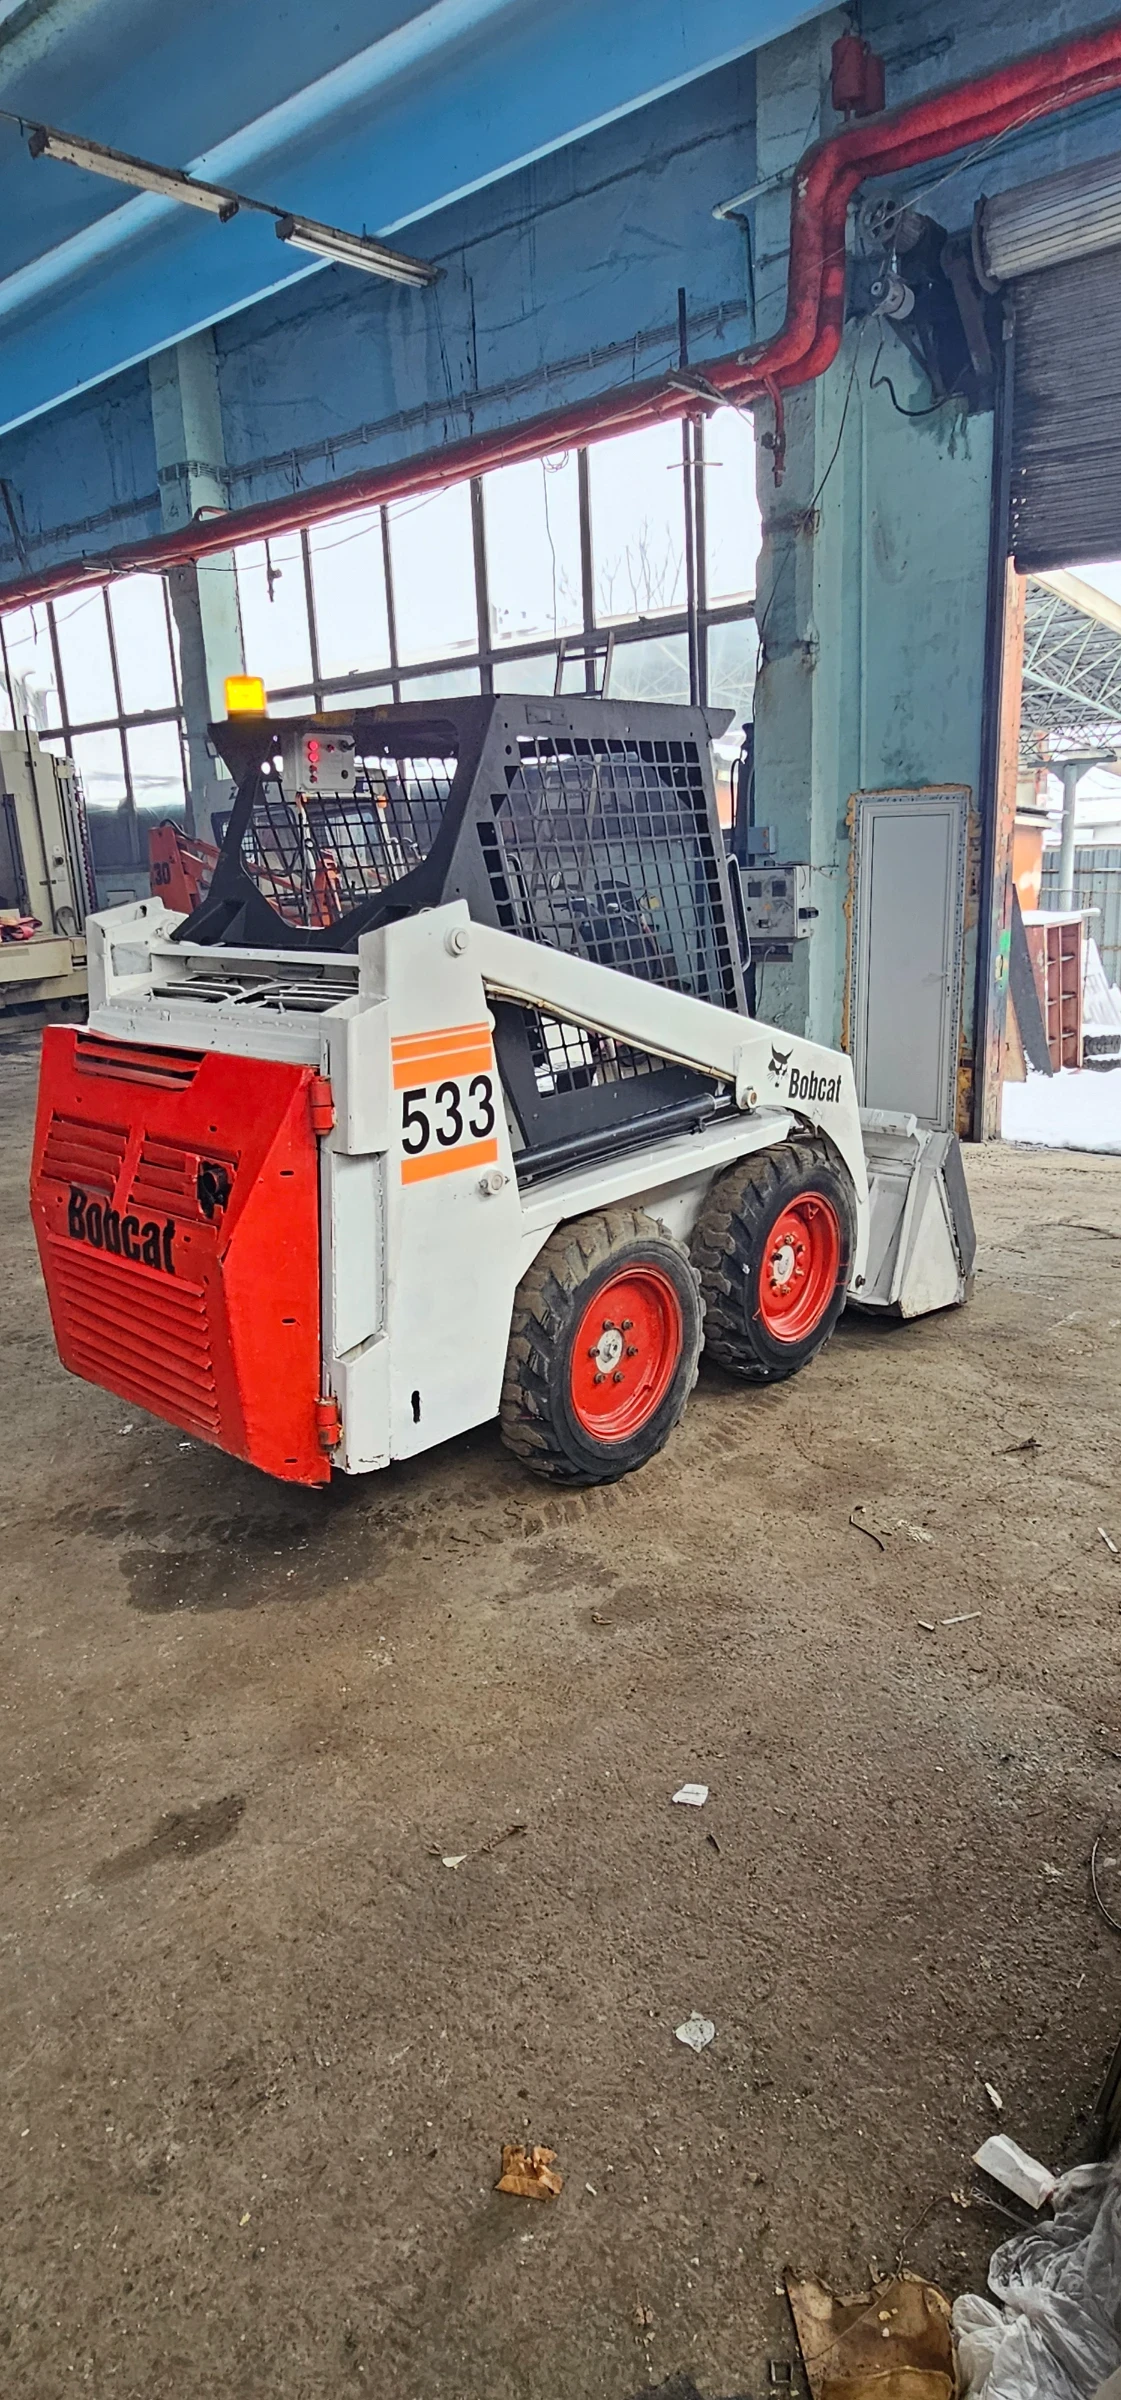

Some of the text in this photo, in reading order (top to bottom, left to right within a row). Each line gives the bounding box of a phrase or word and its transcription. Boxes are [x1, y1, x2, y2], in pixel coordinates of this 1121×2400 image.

[402, 1075, 495, 1154] 533
[788, 1068, 842, 1103] Bobcat
[68, 1184, 176, 1275] Bobcat
